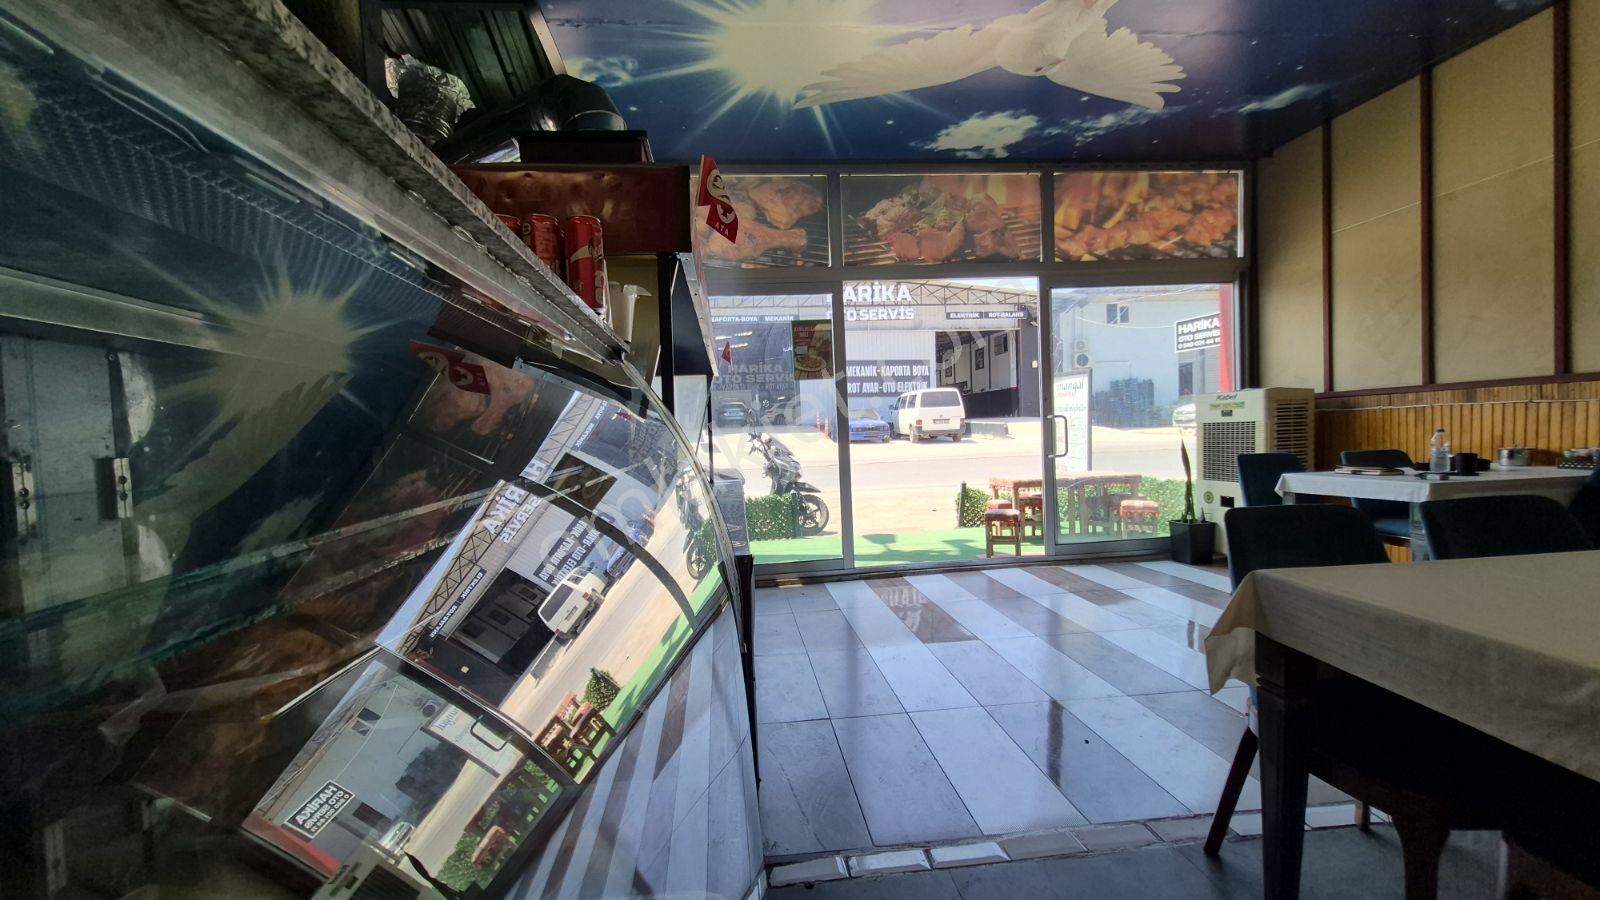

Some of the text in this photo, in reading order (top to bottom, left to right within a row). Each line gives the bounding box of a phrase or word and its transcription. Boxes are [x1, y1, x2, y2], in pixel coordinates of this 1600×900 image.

[860, 307, 915, 320] SERVİS
[1177, 317, 1220, 334] HARİKA
[1177, 334, 1193, 343] OTO
[912, 365, 930, 376] BOYA
[847, 382, 861, 394] ROT
